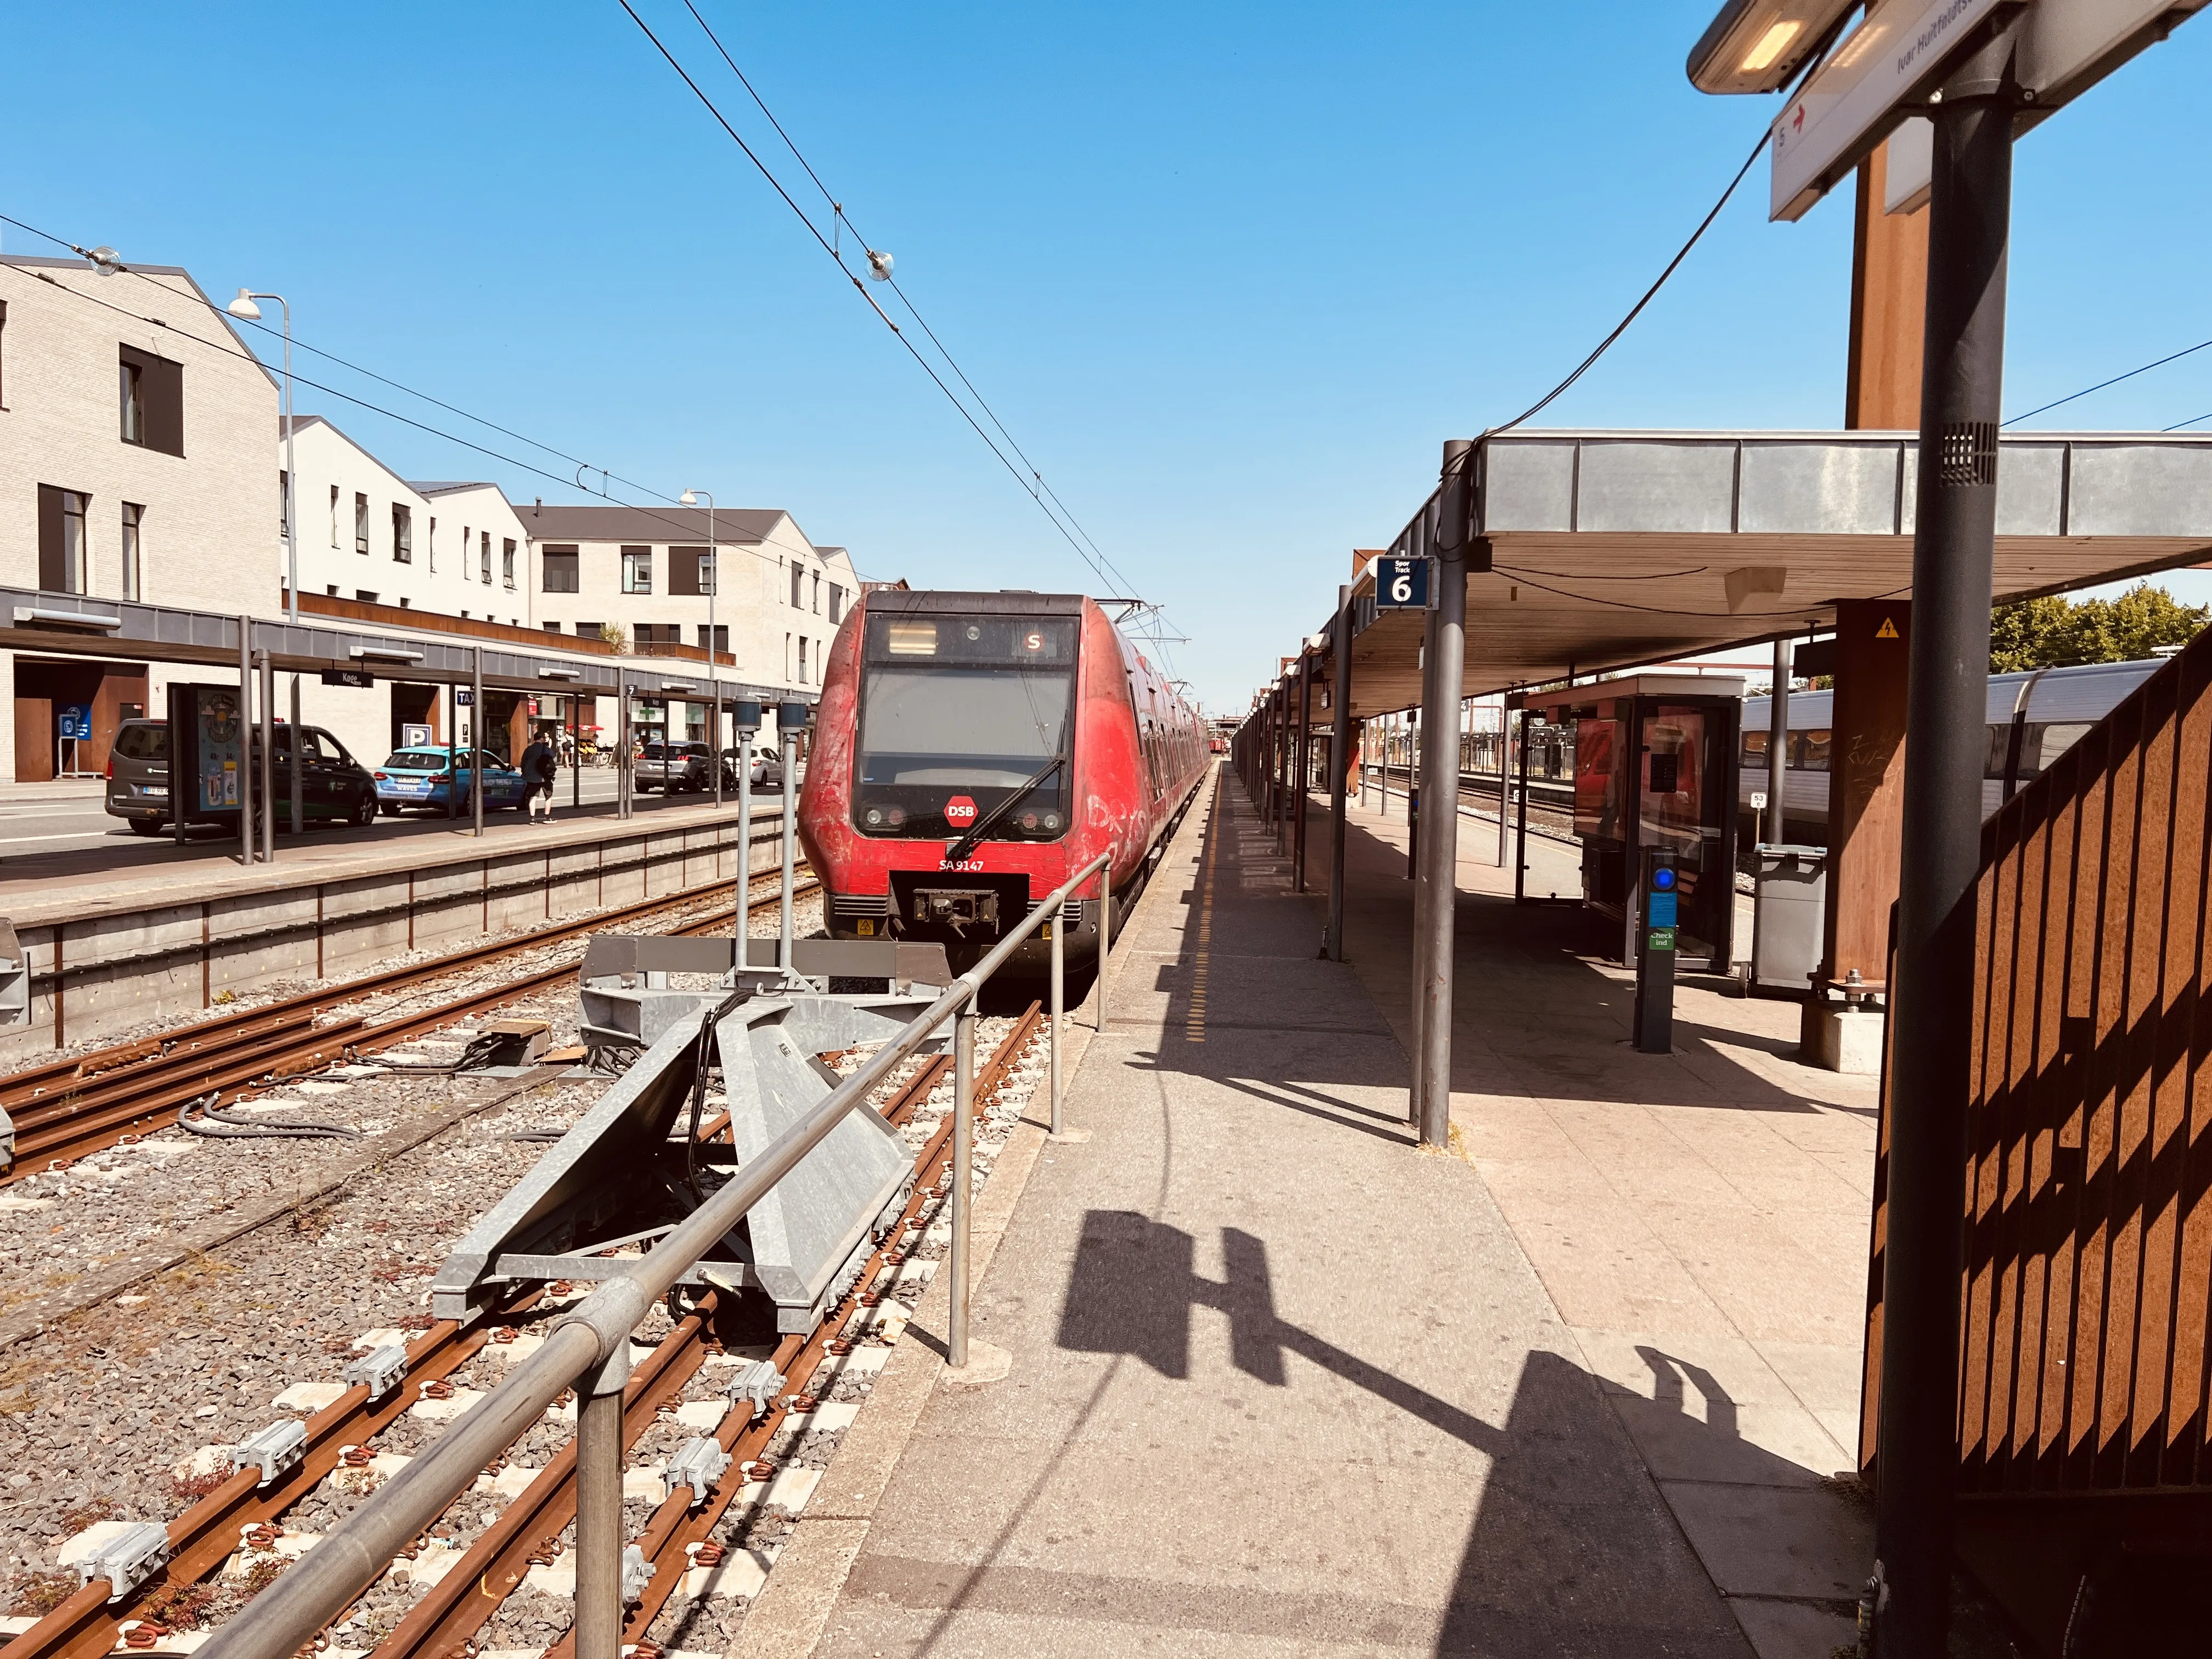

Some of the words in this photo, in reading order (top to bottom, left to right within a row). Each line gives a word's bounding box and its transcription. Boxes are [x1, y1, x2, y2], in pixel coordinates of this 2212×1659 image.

[1898, 46, 1916, 74] Ivar
[1917, 0, 1972, 54] Huitfeldts
[1779, 127, 1785, 147] 5
[1392, 575, 1412, 602] 6
[1028, 635, 1041, 649] S
[342, 673, 358, 684] Køge
[459, 693, 475, 704] TAX
[410, 729, 425, 747] P
[948, 805, 974, 817] DSB
[939, 859, 955, 871] SA
[956, 860, 984, 871] 9147
